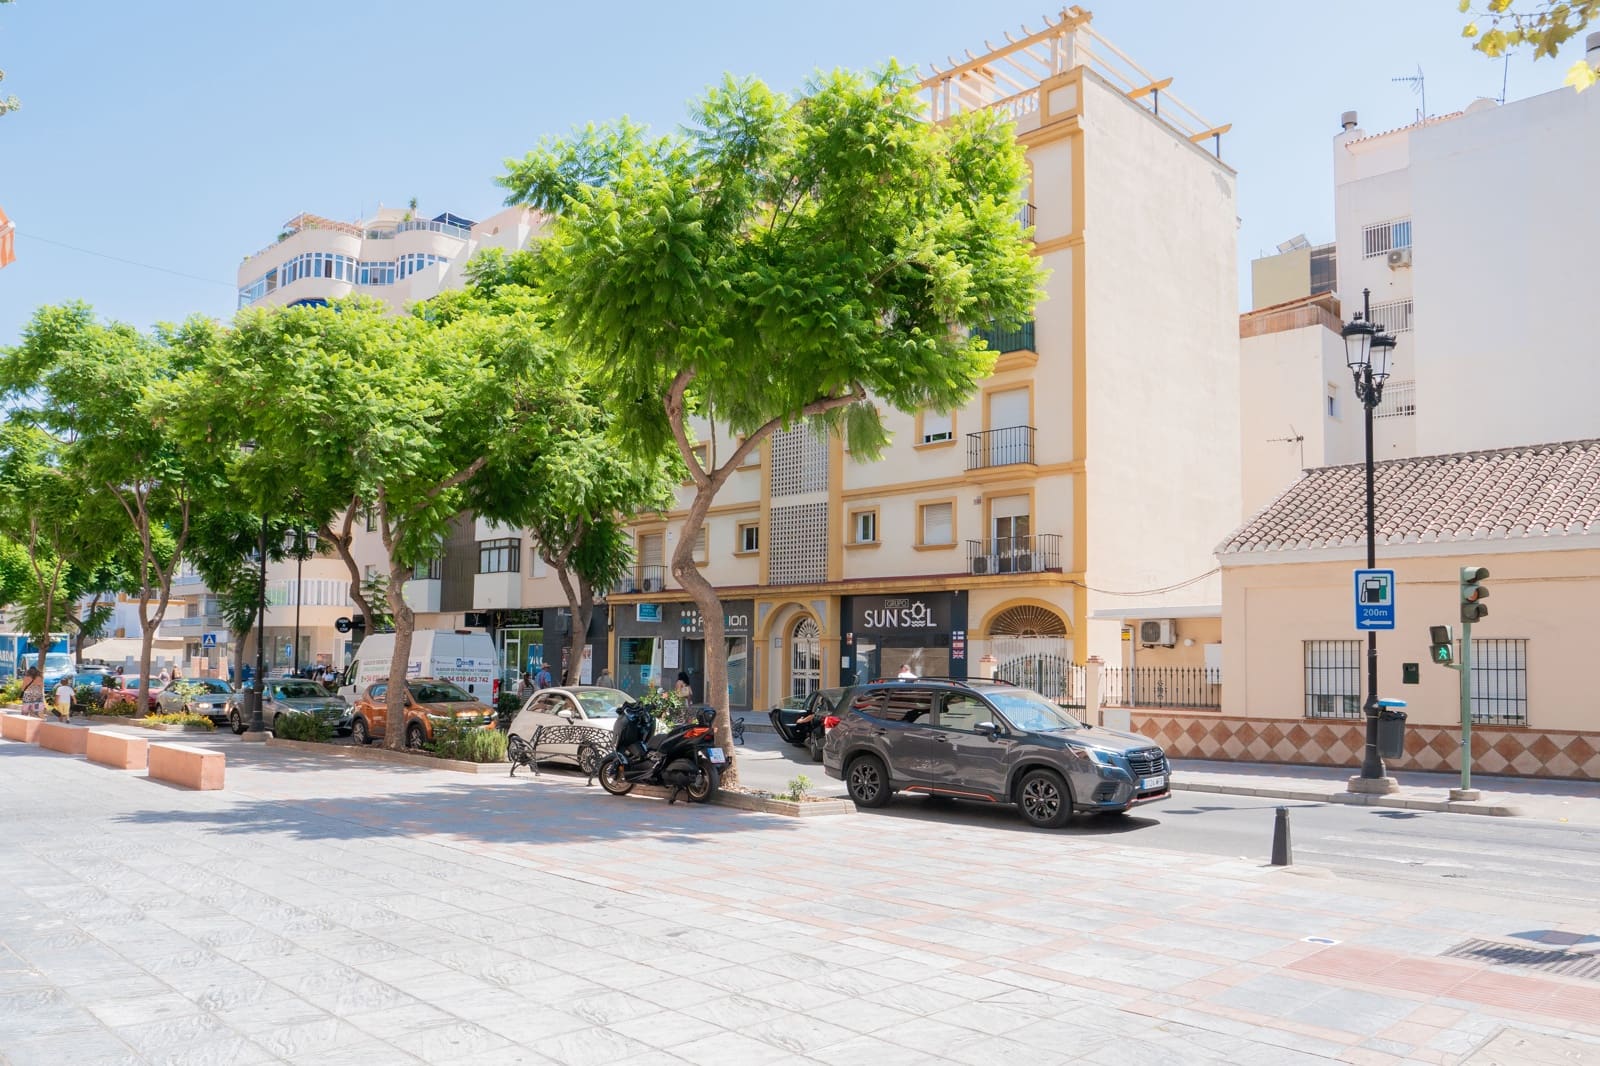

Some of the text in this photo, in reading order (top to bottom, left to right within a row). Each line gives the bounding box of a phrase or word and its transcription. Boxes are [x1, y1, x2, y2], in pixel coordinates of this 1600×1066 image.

[864, 601, 937, 628] SUN SOL
[1363, 608, 1388, 617] 200m
